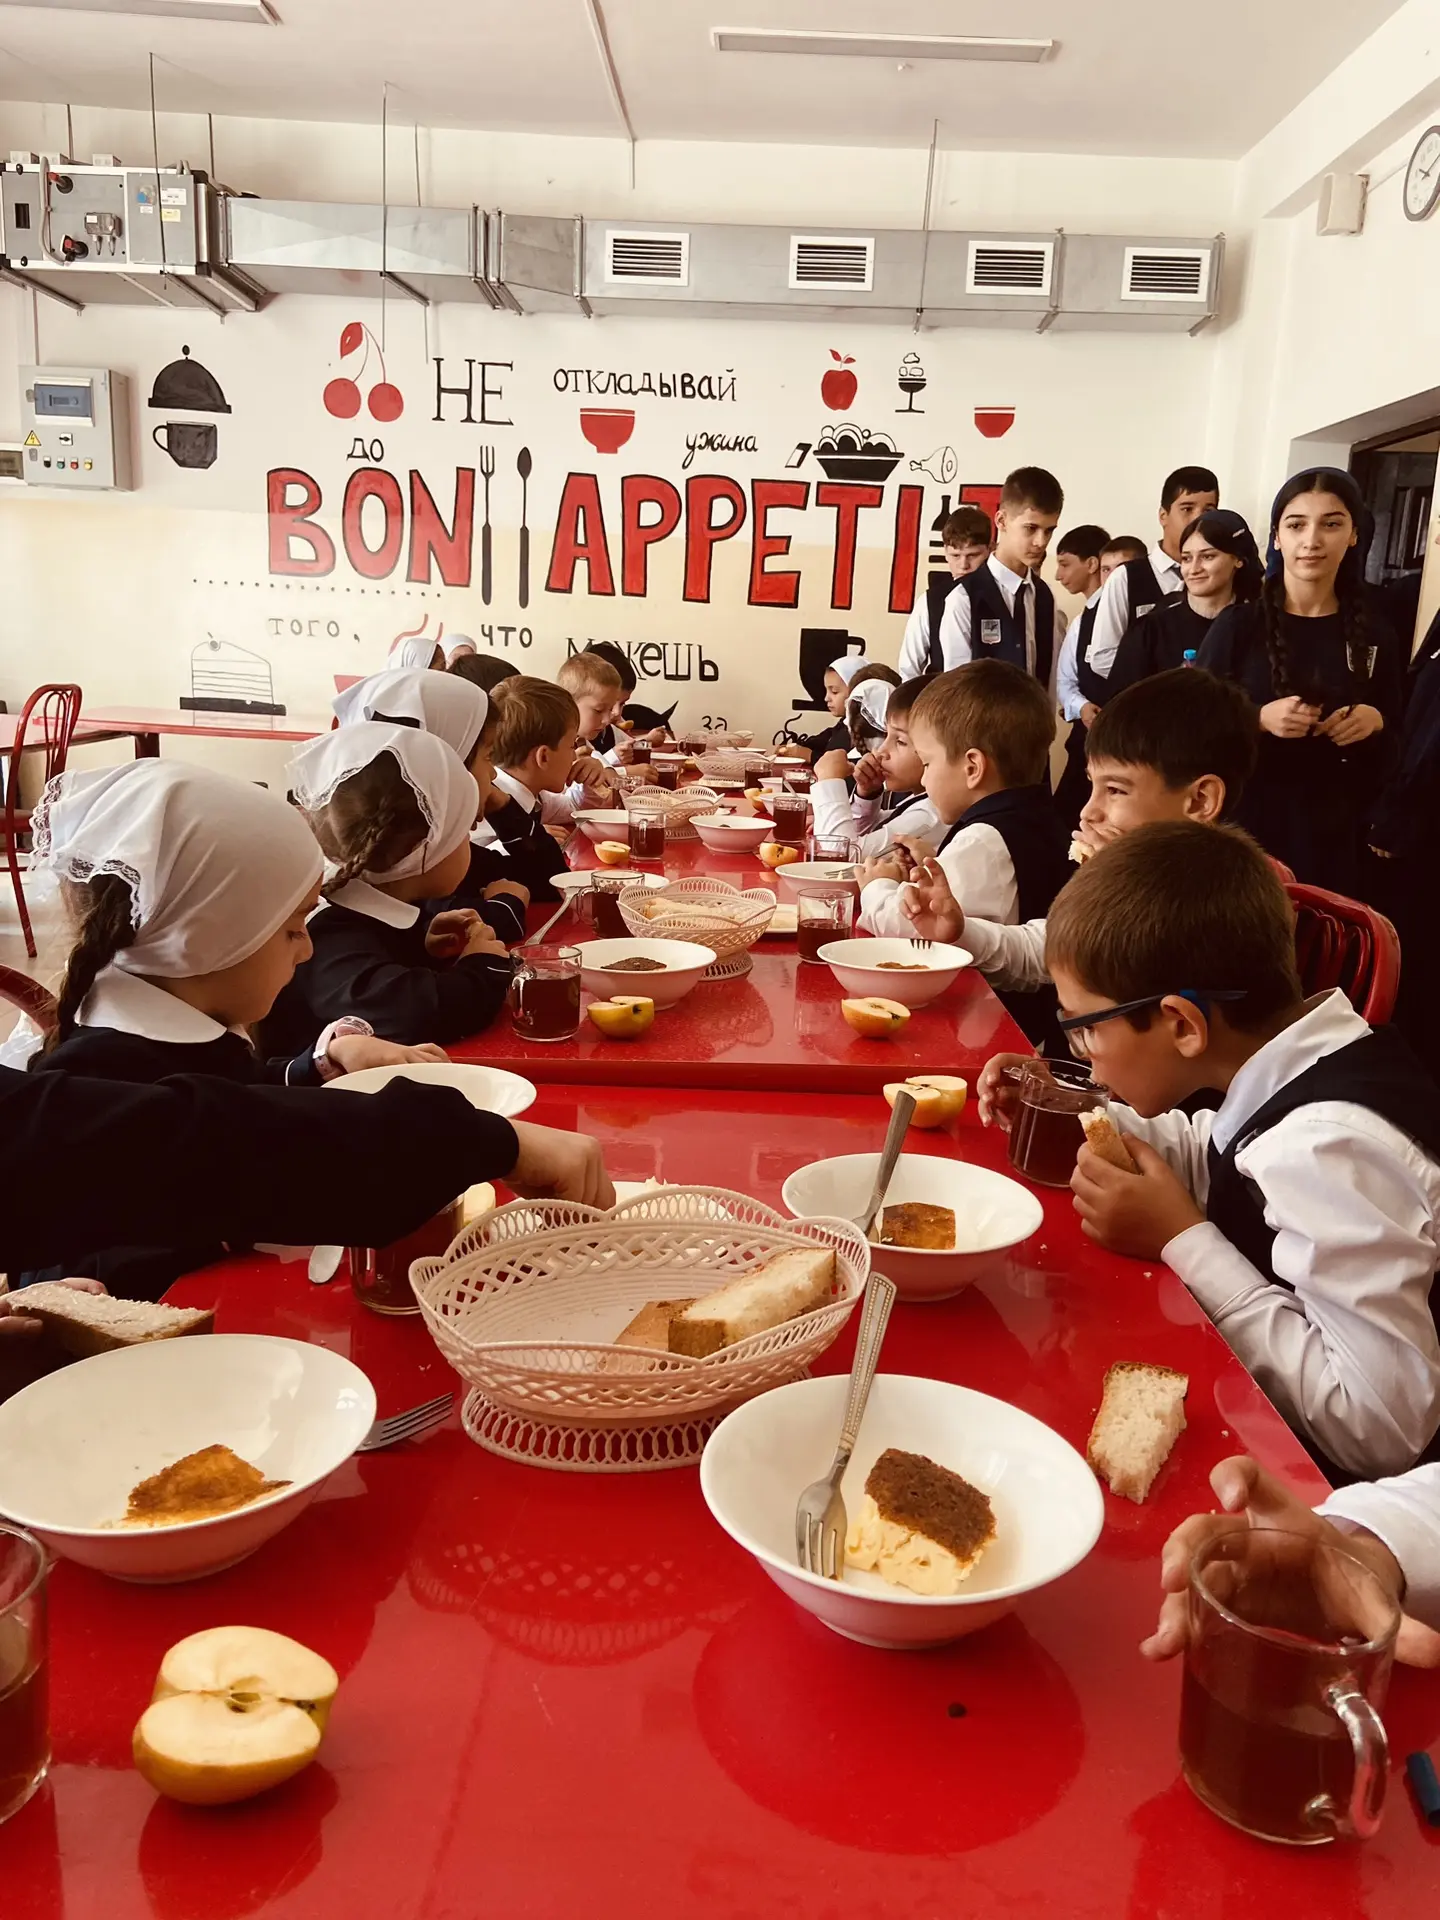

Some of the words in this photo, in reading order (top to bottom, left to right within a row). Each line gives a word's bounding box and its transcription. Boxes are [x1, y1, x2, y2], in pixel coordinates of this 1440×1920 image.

[432, 357, 514, 426] НЕ
[553, 368, 737, 401] откладывай
[681, 432, 759, 470] ужина
[267, 467, 475, 588] BON
